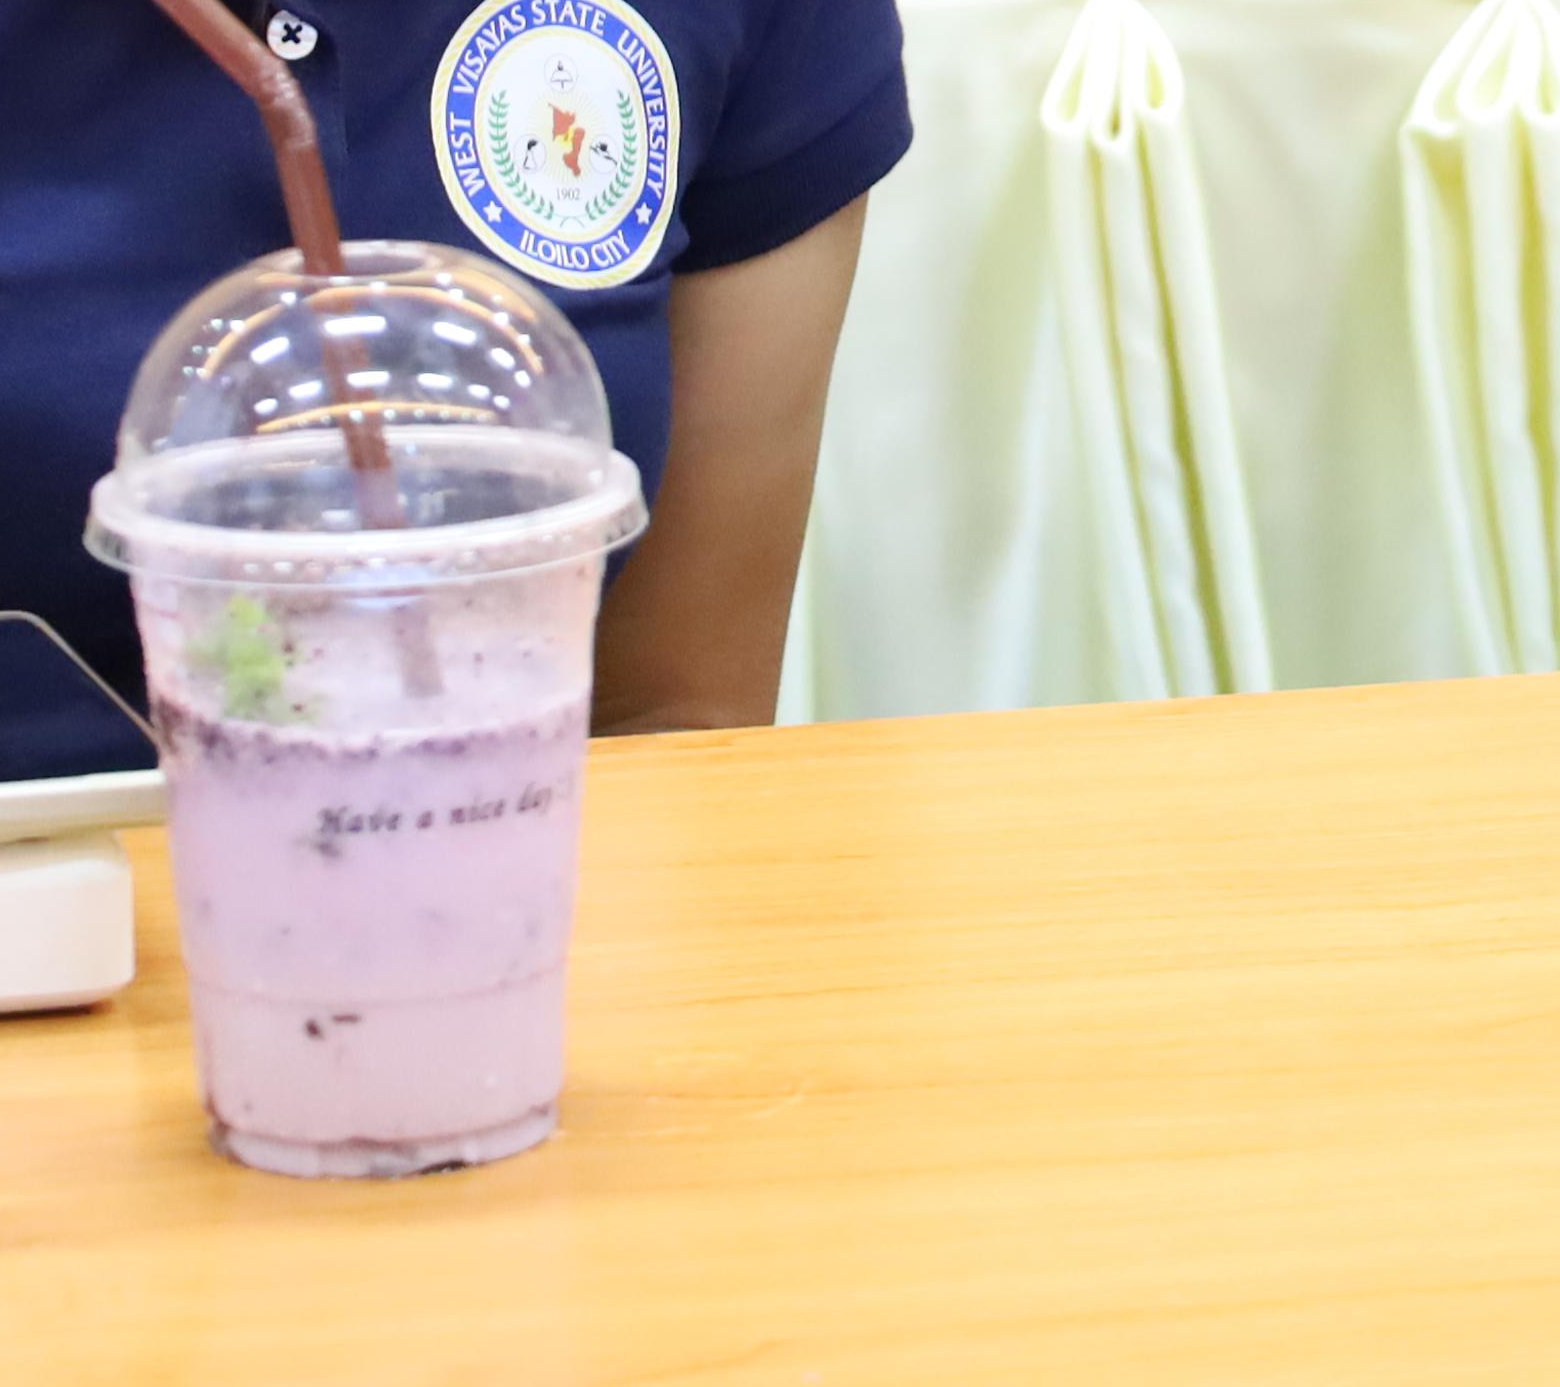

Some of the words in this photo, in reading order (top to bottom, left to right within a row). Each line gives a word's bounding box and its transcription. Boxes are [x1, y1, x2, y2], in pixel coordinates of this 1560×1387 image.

[452, 4, 527, 95] VISAYAS
[616, 29, 665, 198] UNIVERSITY
[449, 111, 485, 197] WEST
[555, 186, 581, 202] 1902
[519, 229, 590, 270] ILOILO
[590, 229, 632, 270] CITY
[317, 805, 401, 833] Have
[416, 810, 433, 829] a
[449, 795, 506, 825] nice
